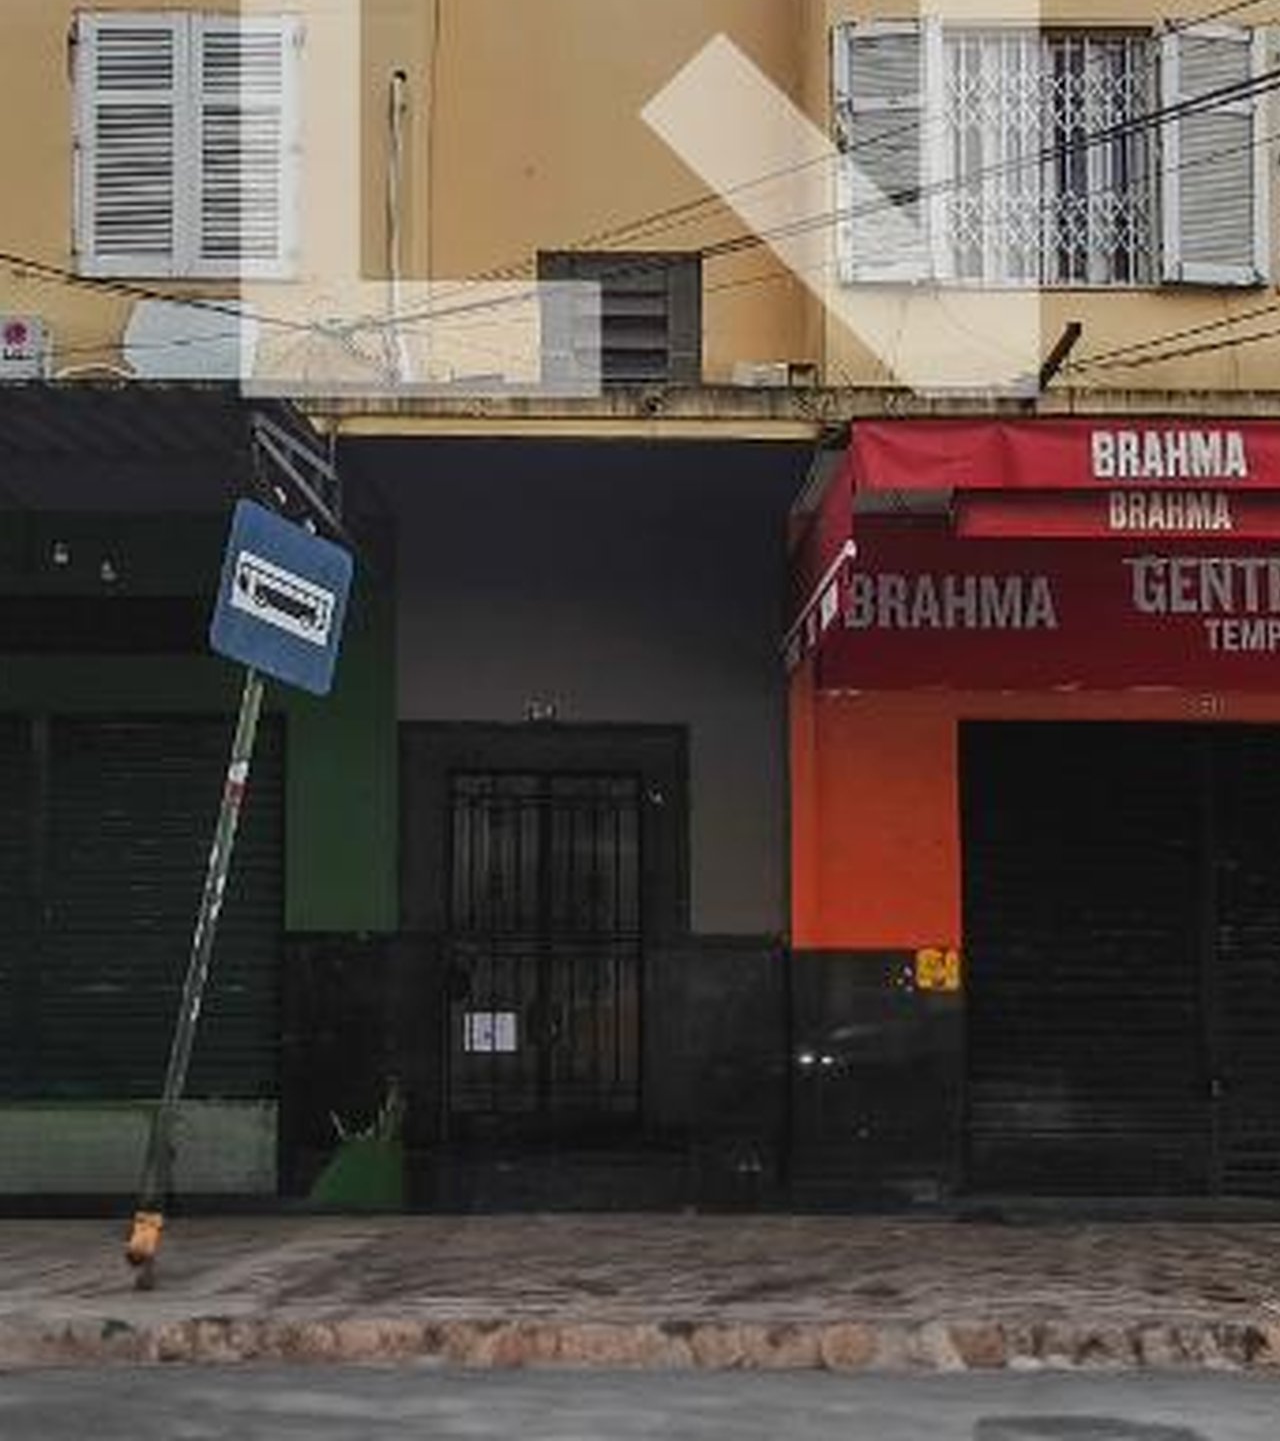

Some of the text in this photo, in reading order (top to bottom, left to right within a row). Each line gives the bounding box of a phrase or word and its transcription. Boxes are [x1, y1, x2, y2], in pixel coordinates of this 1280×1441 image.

[1091, 431, 1248, 479] BRAHMA
[1109, 492, 1232, 531] BRAHMA
[845, 572, 1058, 630] BRAHMA
